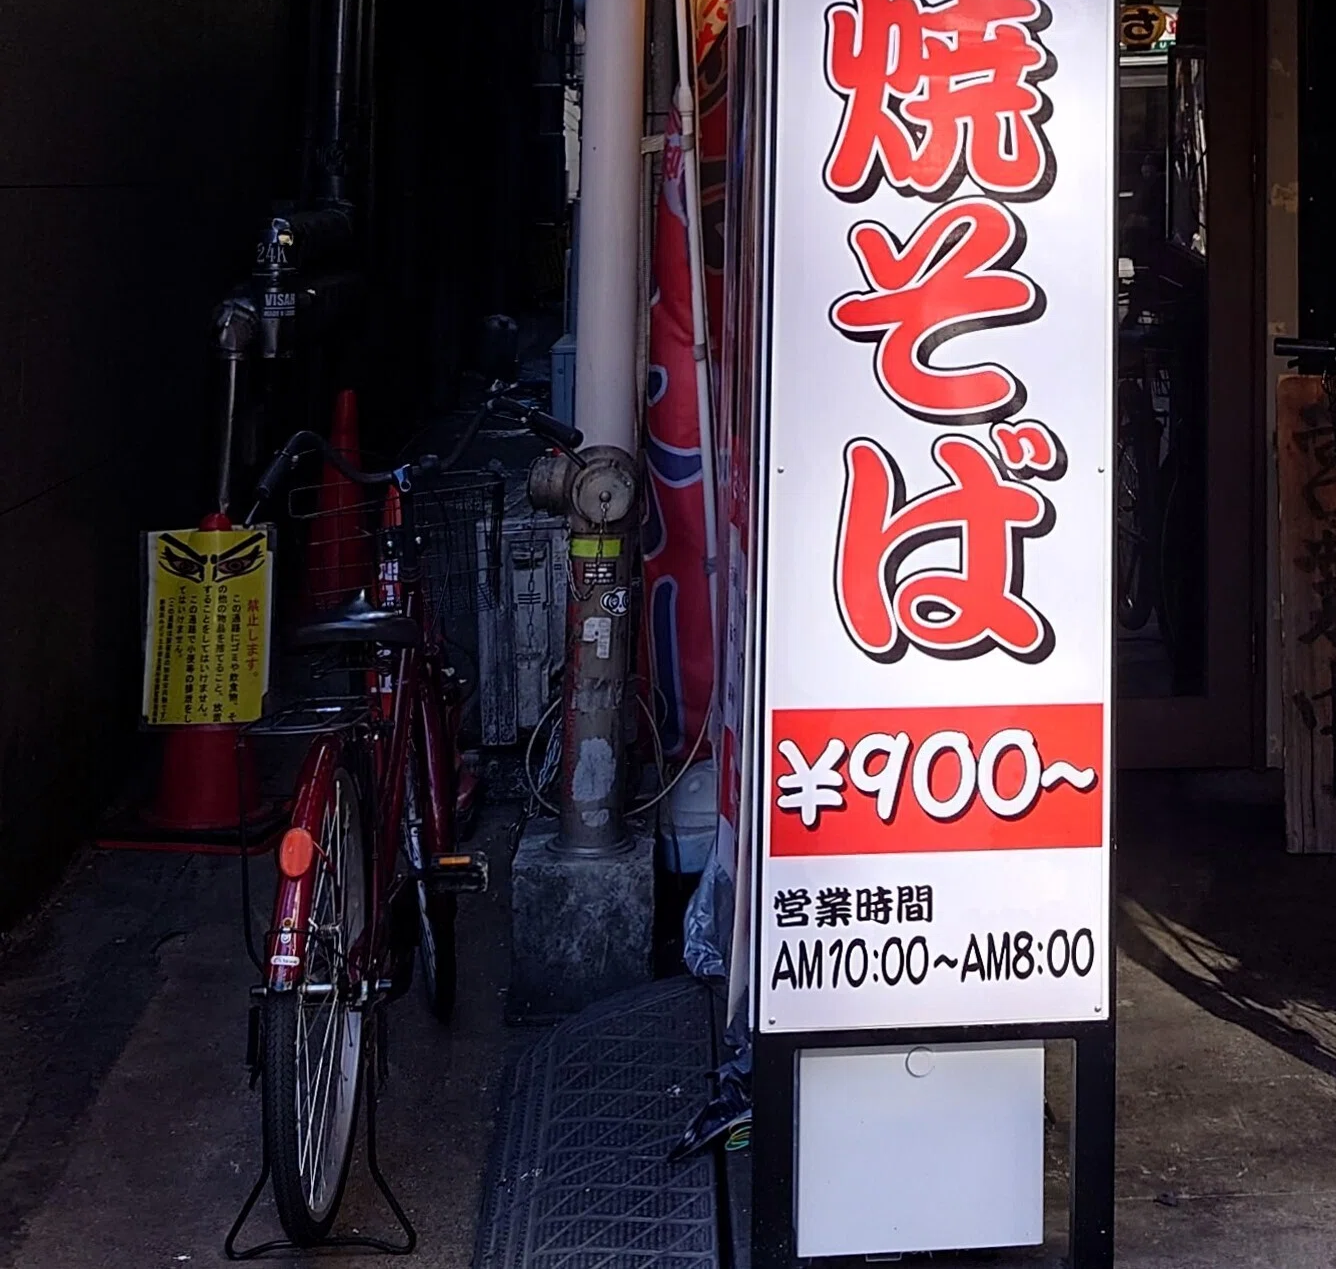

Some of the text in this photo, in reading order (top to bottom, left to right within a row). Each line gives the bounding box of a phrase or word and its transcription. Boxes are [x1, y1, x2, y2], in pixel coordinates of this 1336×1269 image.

[246, 598, 260, 678] 禁止します。
[773, 885, 934, 929] 営業時間
